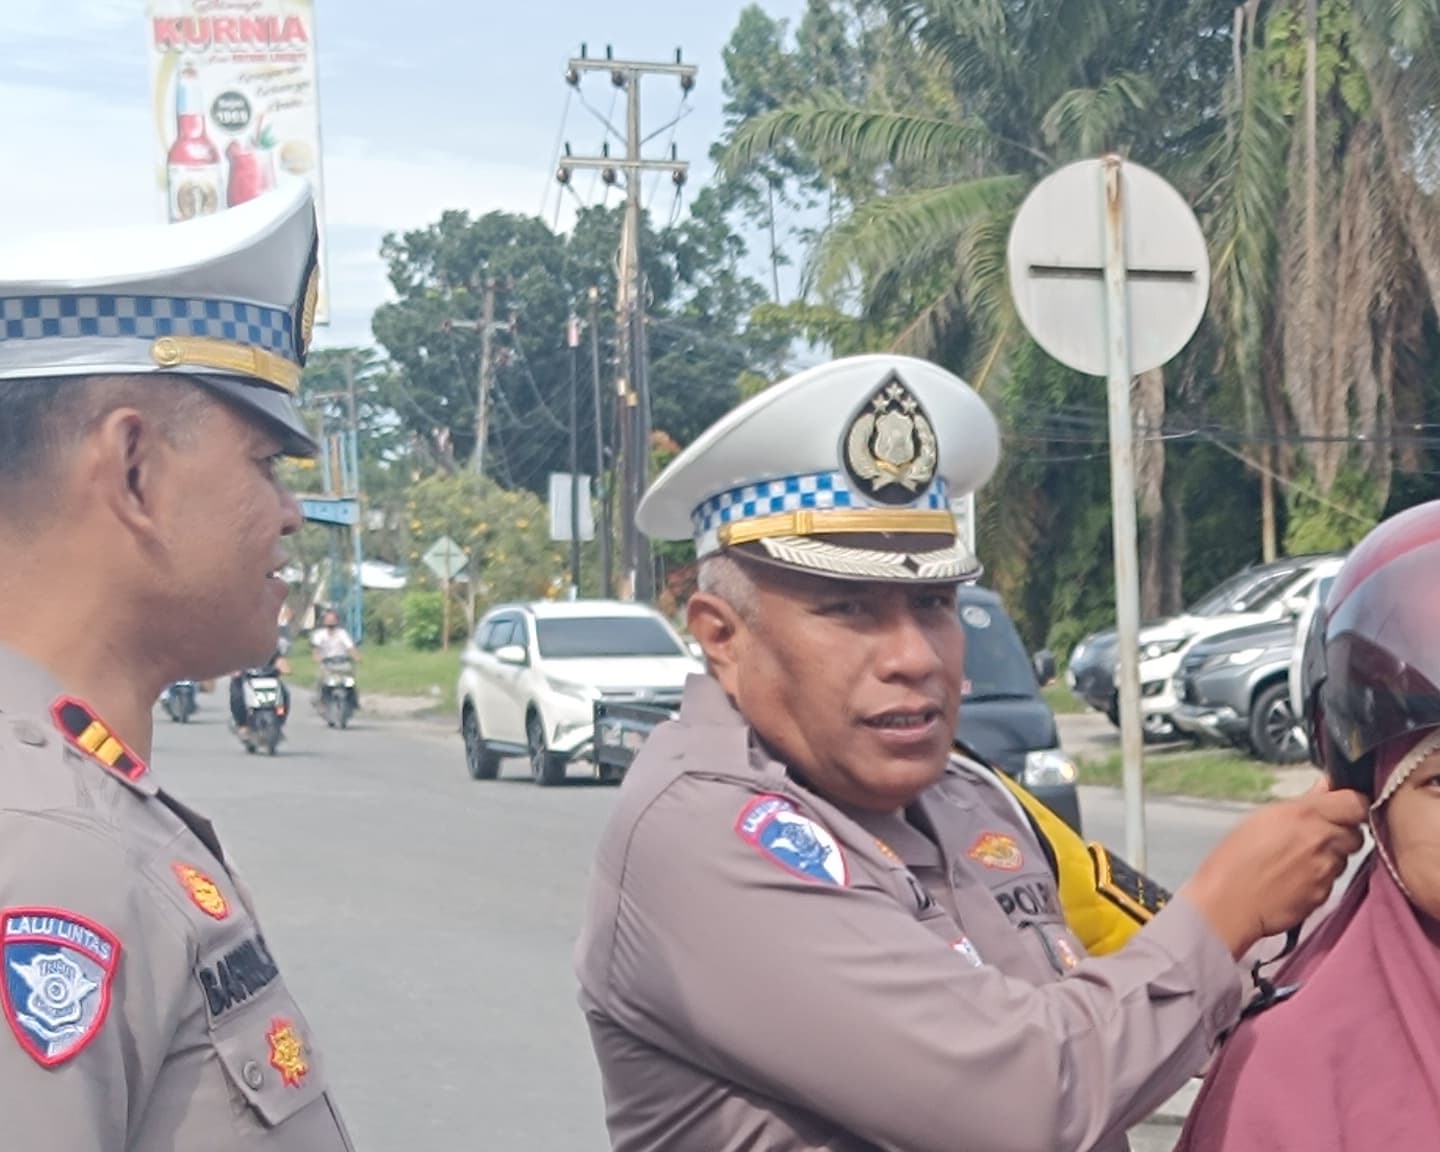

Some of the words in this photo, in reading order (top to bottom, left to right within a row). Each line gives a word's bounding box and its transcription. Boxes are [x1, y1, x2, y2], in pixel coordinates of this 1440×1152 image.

[153, 15, 309, 47] KURNIA
[995, 881, 1056, 917] POL
[7, 917, 53, 935] LALU
[58, 920, 111, 960] LINTAS
